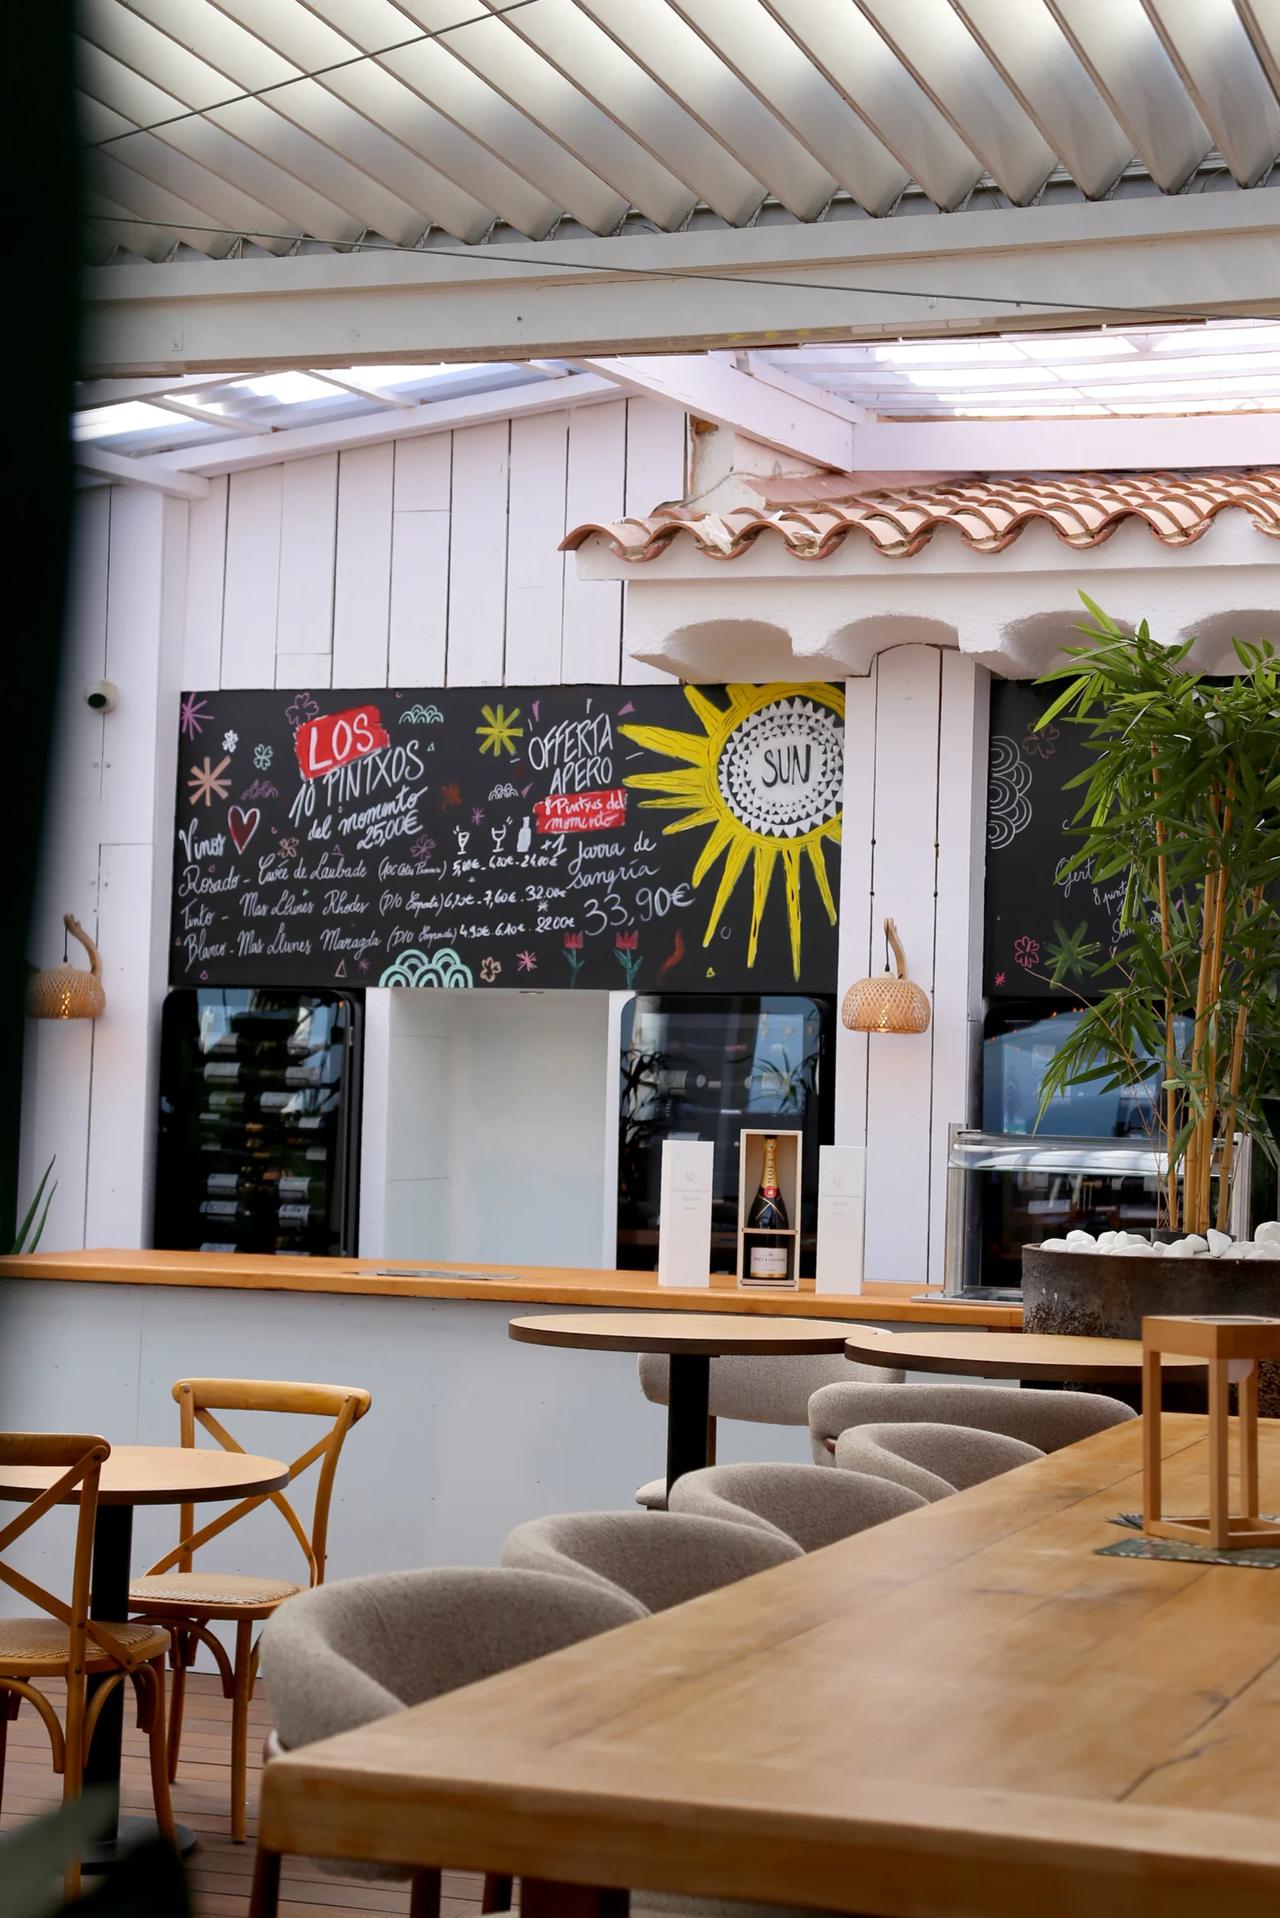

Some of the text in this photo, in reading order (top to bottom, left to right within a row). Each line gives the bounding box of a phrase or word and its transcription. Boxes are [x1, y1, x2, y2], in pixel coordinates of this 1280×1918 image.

[309, 713, 373, 771] LOS
[528, 712, 613, 770] OFFERTA
[288, 740, 424, 828] 10 PINTXOS
[550, 756, 613, 795] APERO
[761, 744, 812, 788] SUN
[308, 785, 428, 841] del momento
[179, 818, 226, 862] Vinos
[633, 831, 657, 852] de
[178, 864, 240, 896] Rosado
[180, 898, 215, 930] Tinto
[239, 892, 269, 917] Mas
[584, 882, 696, 936] 33,90€
[183, 928, 227, 972] Blanco
[237, 929, 264, 957] Mas
